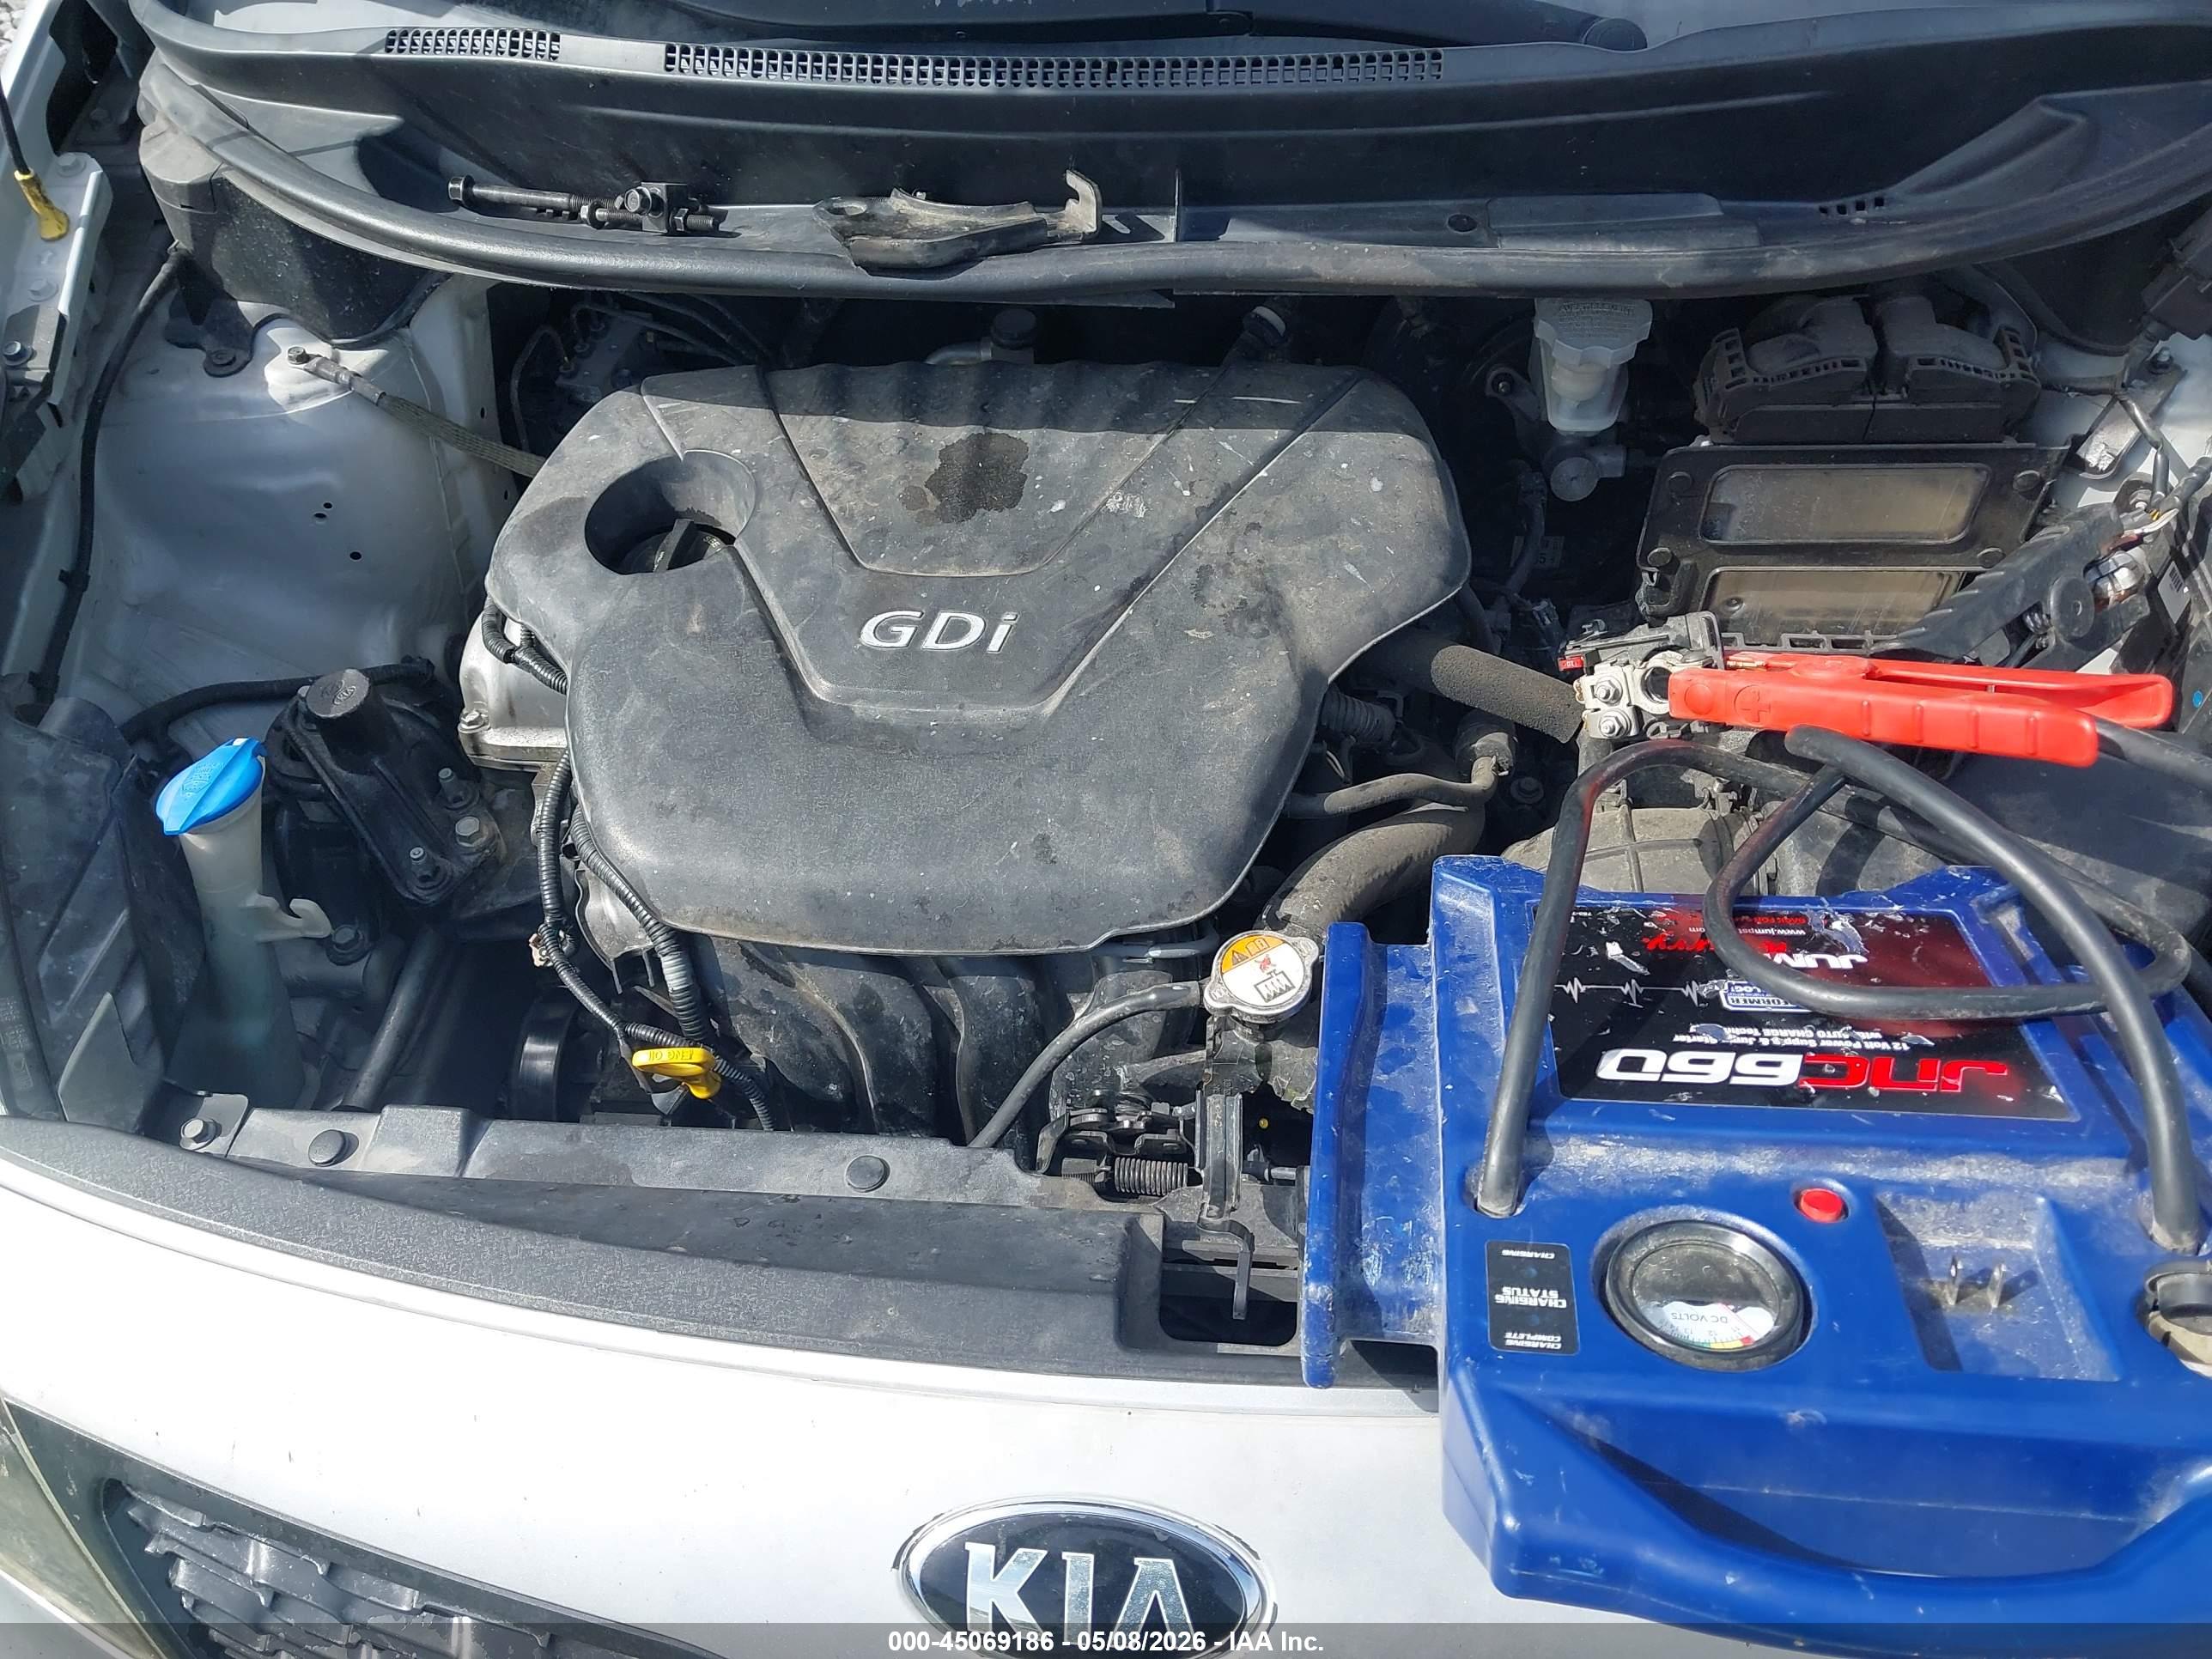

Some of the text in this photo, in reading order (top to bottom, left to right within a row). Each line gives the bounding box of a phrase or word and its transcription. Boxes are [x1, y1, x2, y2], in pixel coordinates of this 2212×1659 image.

[859, 610, 1019, 654] GDi
[1672, 1033, 1717, 1043] Starter
[1762, 1028, 1814, 1039] CHARGE
[1759, 1036, 1770, 1046] &
[1818, 1039, 1862, 1049] Power
[1862, 1040, 1891, 1050] Volt
[1891, 1042, 1910, 1051] 12
[1501, 1249, 1555, 1260] CHARGING
[1502, 1285, 1559, 1299] STATUS
[1494, 1293, 1567, 1309] CHARGING
[1670, 1312, 1729, 1324] DC VOLTS
[1504, 1332, 1562, 1342] COMPLETE
[1504, 1339, 1562, 1350] CHARGING
[964, 1541, 1196, 1649] KIA
